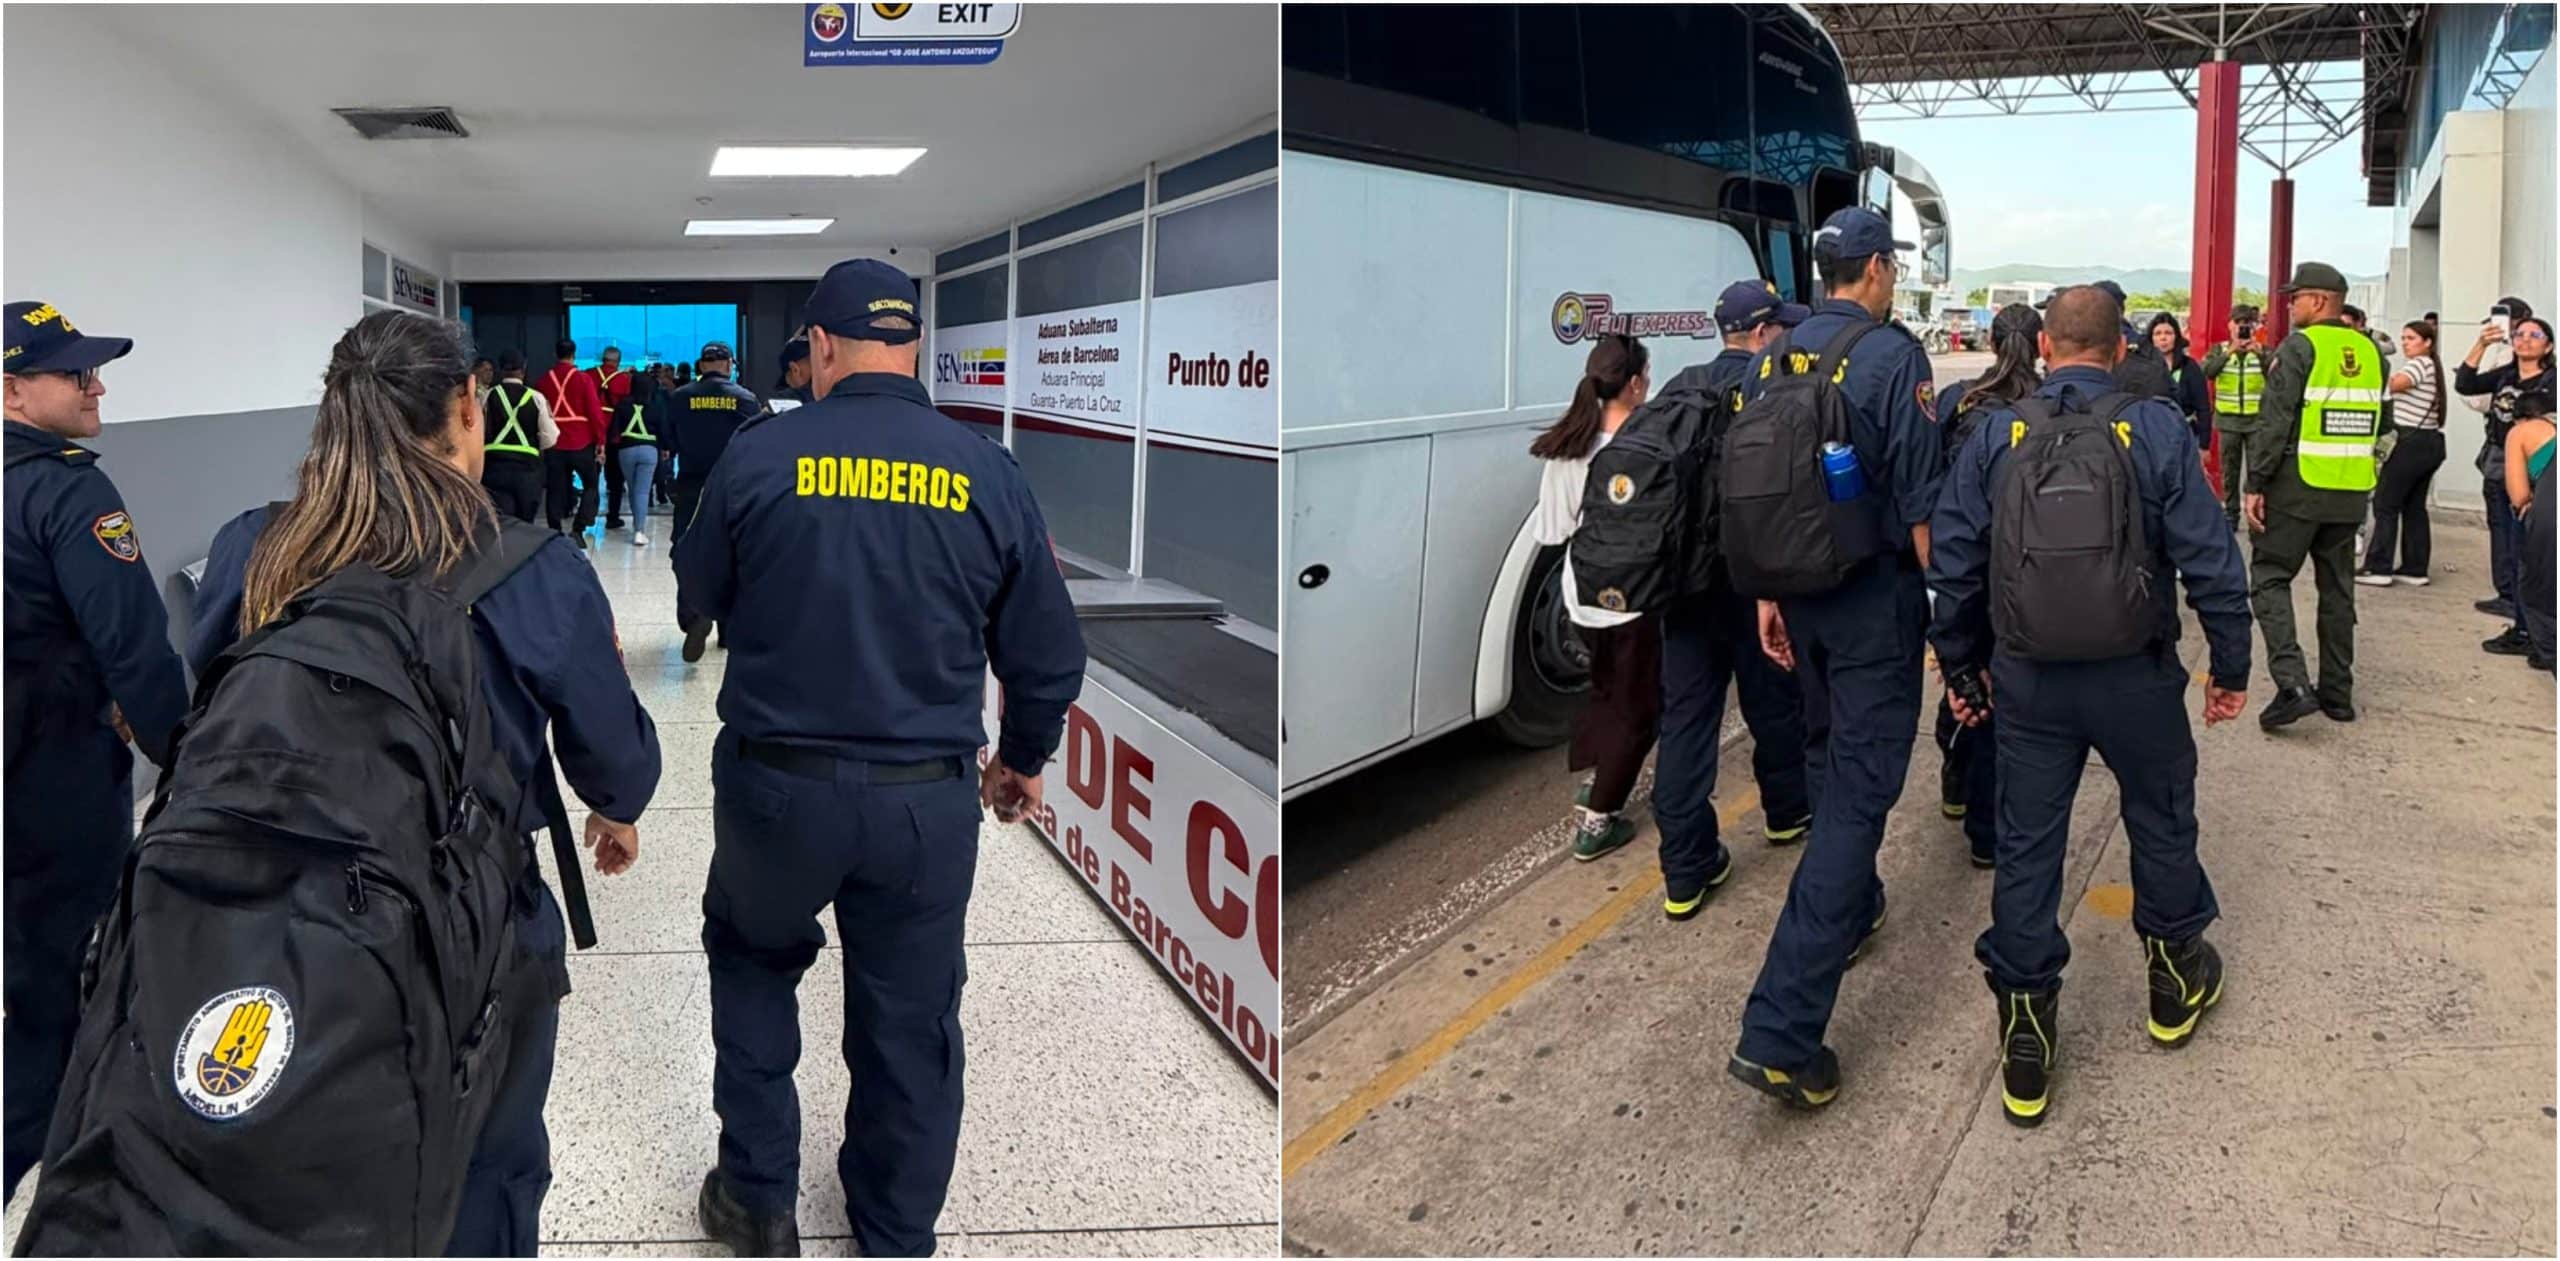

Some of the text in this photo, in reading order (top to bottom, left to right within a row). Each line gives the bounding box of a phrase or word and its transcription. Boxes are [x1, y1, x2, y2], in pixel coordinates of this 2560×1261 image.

[938, 4, 993, 23] EXIT
[921, 47, 951, 56] ANTONIO
[1038, 317, 1118, 339] Aduana Subalterna
[1631, 312, 1706, 334] EXPRESS
[1038, 345, 1119, 364] Aérea de Barcelona
[1168, 350, 1270, 388] Punto de
[1041, 370, 1105, 390] Aduana Principal
[689, 397, 737, 411] BOMBEROS
[1060, 394, 1085, 410] Puerto
[1087, 395, 1097, 411] La
[1099, 395, 1121, 413] Cruz
[796, 456, 971, 513] BOMBEROS
[1067, 702, 1154, 864] DE
[1066, 823, 1101, 885] de
